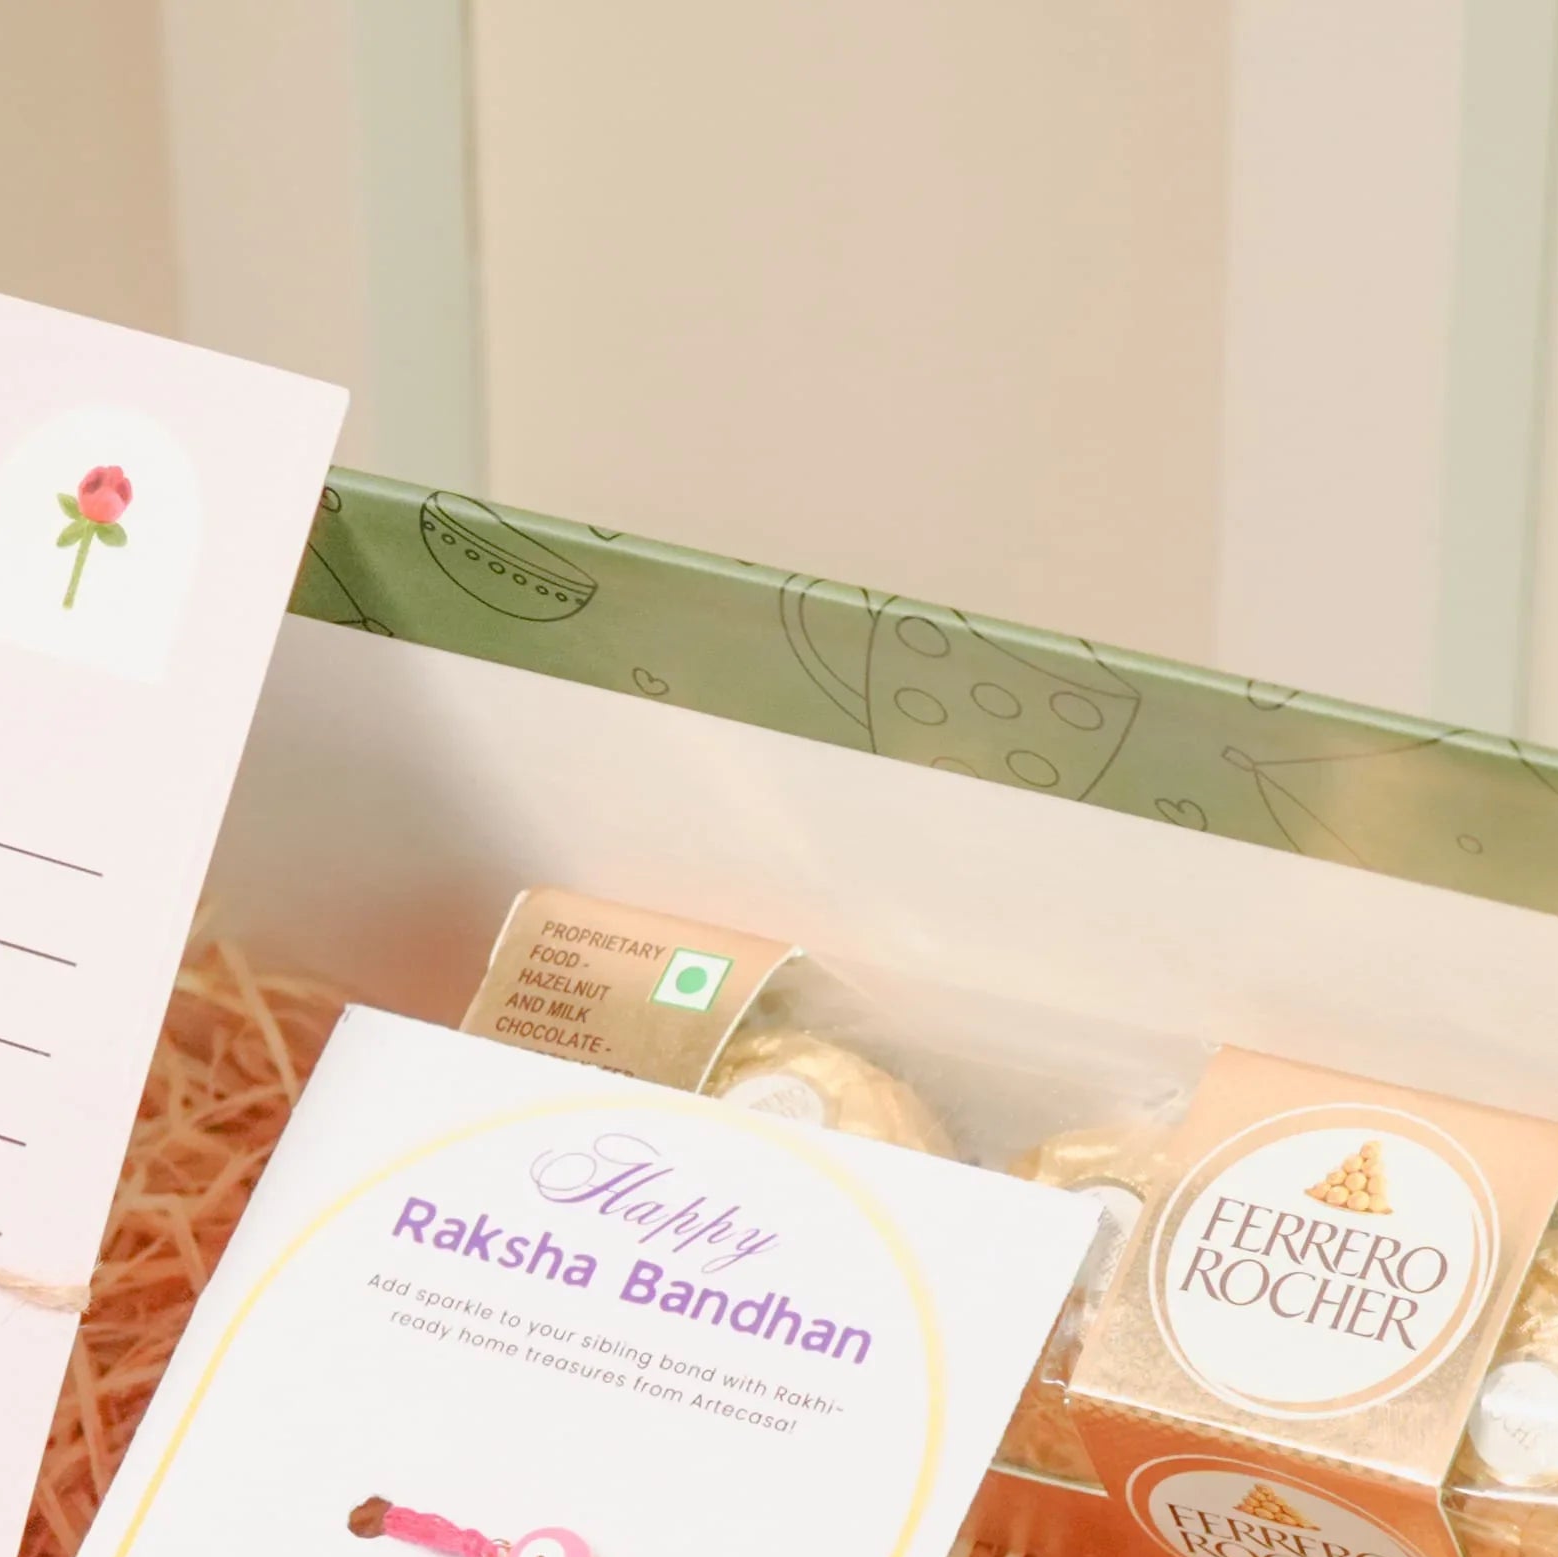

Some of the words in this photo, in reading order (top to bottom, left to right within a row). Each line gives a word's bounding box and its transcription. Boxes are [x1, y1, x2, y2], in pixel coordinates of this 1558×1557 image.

[518, 968, 611, 1000] HAZELNUT
[530, 945, 580, 967] FOOD
[541, 921, 666, 960] PROPRIETARY
[496, 1017, 603, 1052] CHOCOLATE
[505, 993, 545, 1013] AND
[547, 1000, 591, 1023] MILK
[530, 1134, 779, 1274] Happy
[1201, 1197, 1447, 1294] FERRERO
[392, 1197, 597, 1288] Raksha
[619, 1259, 871, 1364] Bandhan
[1179, 1247, 1419, 1351] ROCHER
[368, 1274, 412, 1297] Add
[416, 1290, 494, 1320] sparkle
[500, 1311, 521, 1329] to
[527, 1321, 576, 1343] your
[581, 1336, 654, 1370] sibling
[659, 1354, 717, 1383] bond
[723, 1374, 767, 1397] with
[391, 1311, 453, 1341] ready
[459, 1328, 519, 1357] home
[526, 1346, 627, 1388] treasures
[633, 1376, 684, 1403] from
[690, 1394, 798, 1433] Artecasa!
